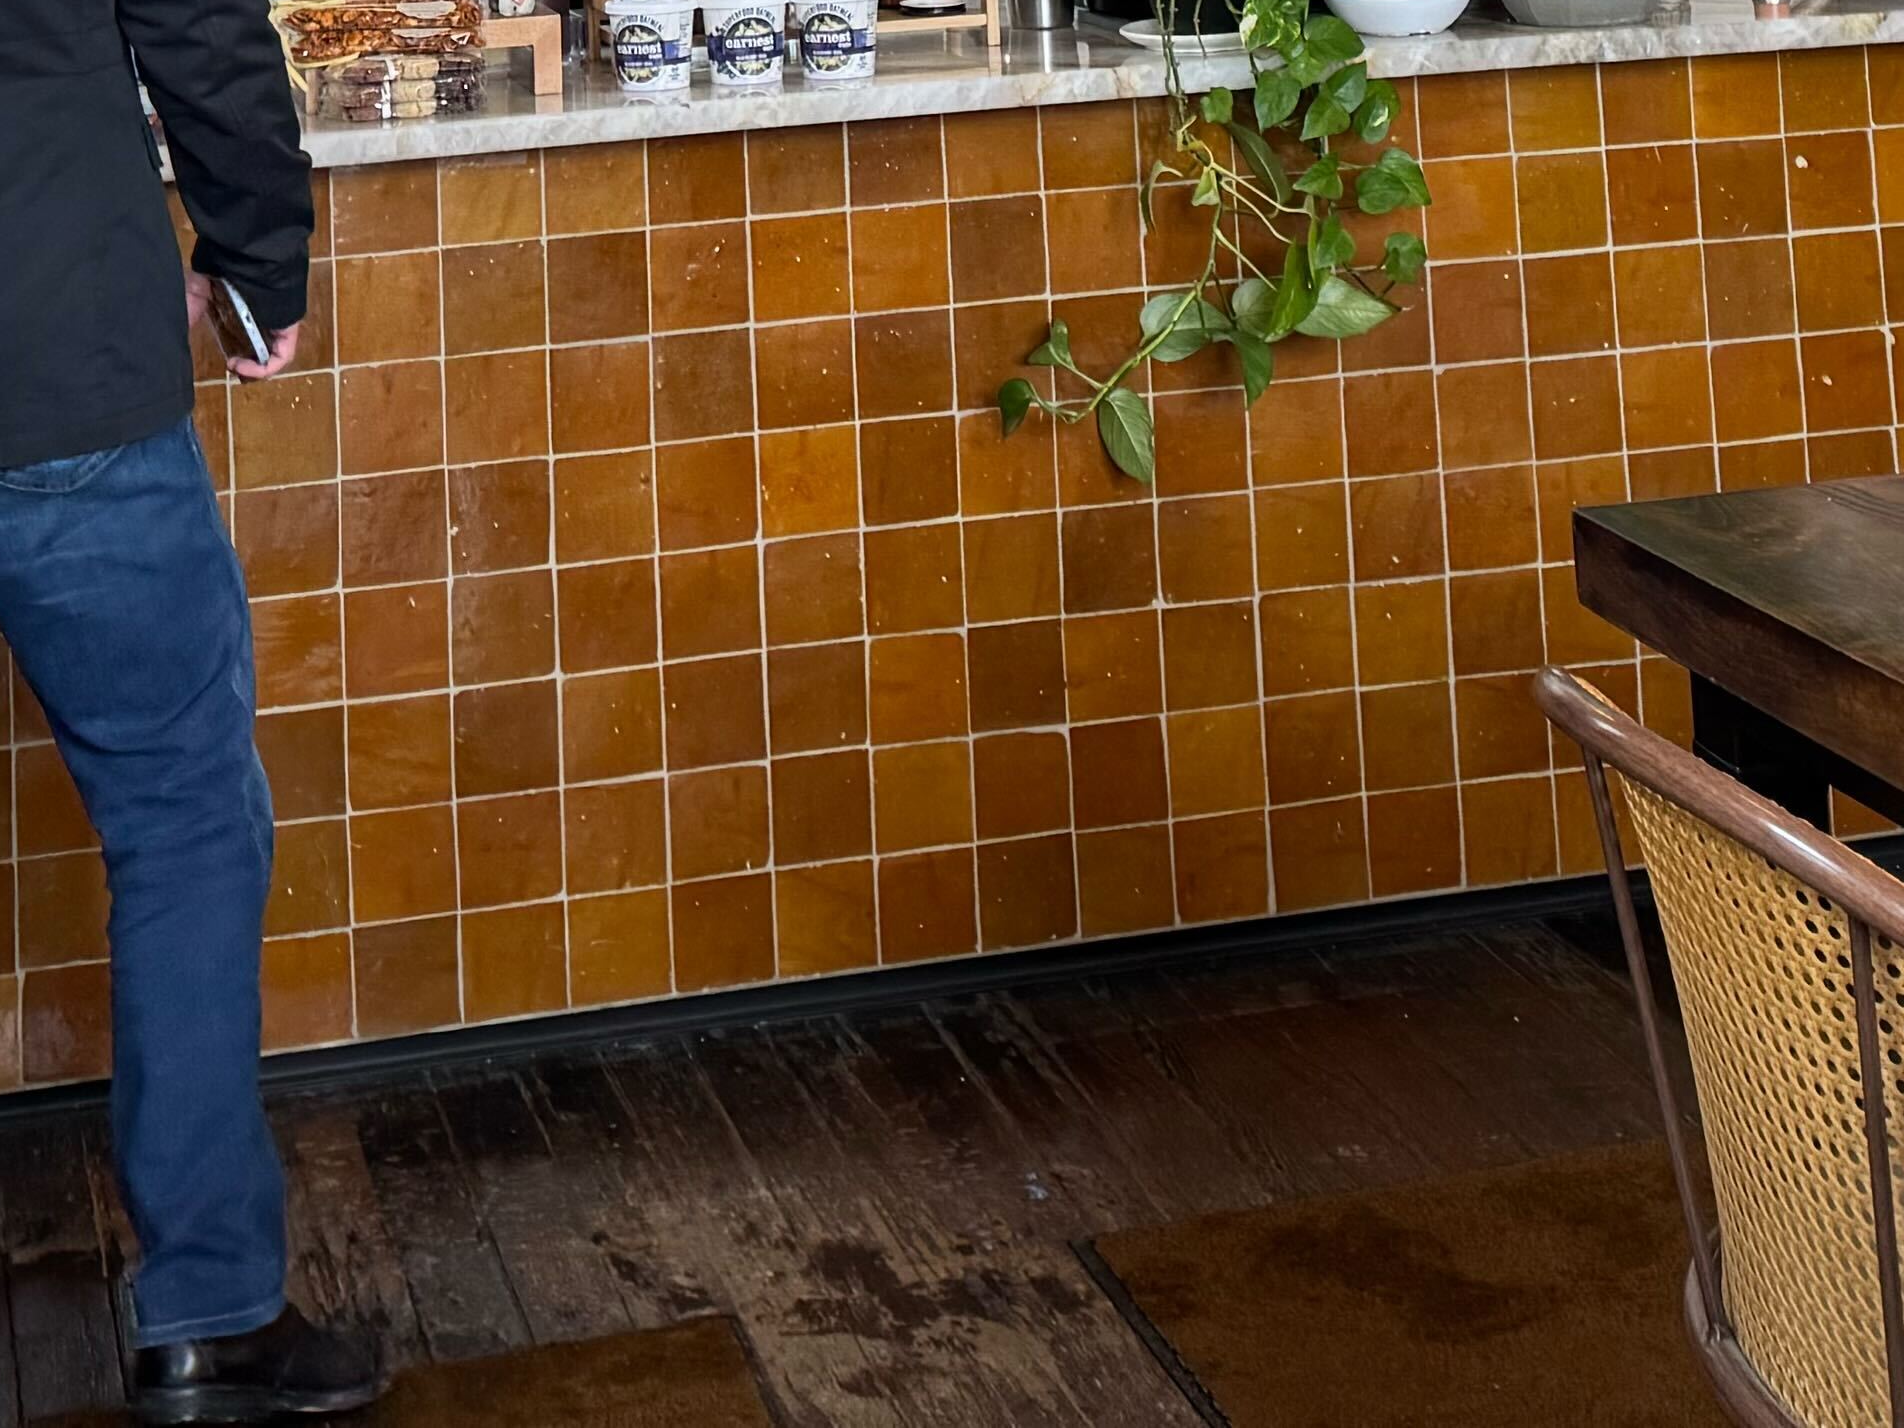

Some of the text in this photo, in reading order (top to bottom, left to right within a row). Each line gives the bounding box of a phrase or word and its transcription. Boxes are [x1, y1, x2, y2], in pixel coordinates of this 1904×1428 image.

[725, 35, 775, 50] earnest
[804, 30, 851, 44] earnest
[616, 41, 663, 56] earnest
